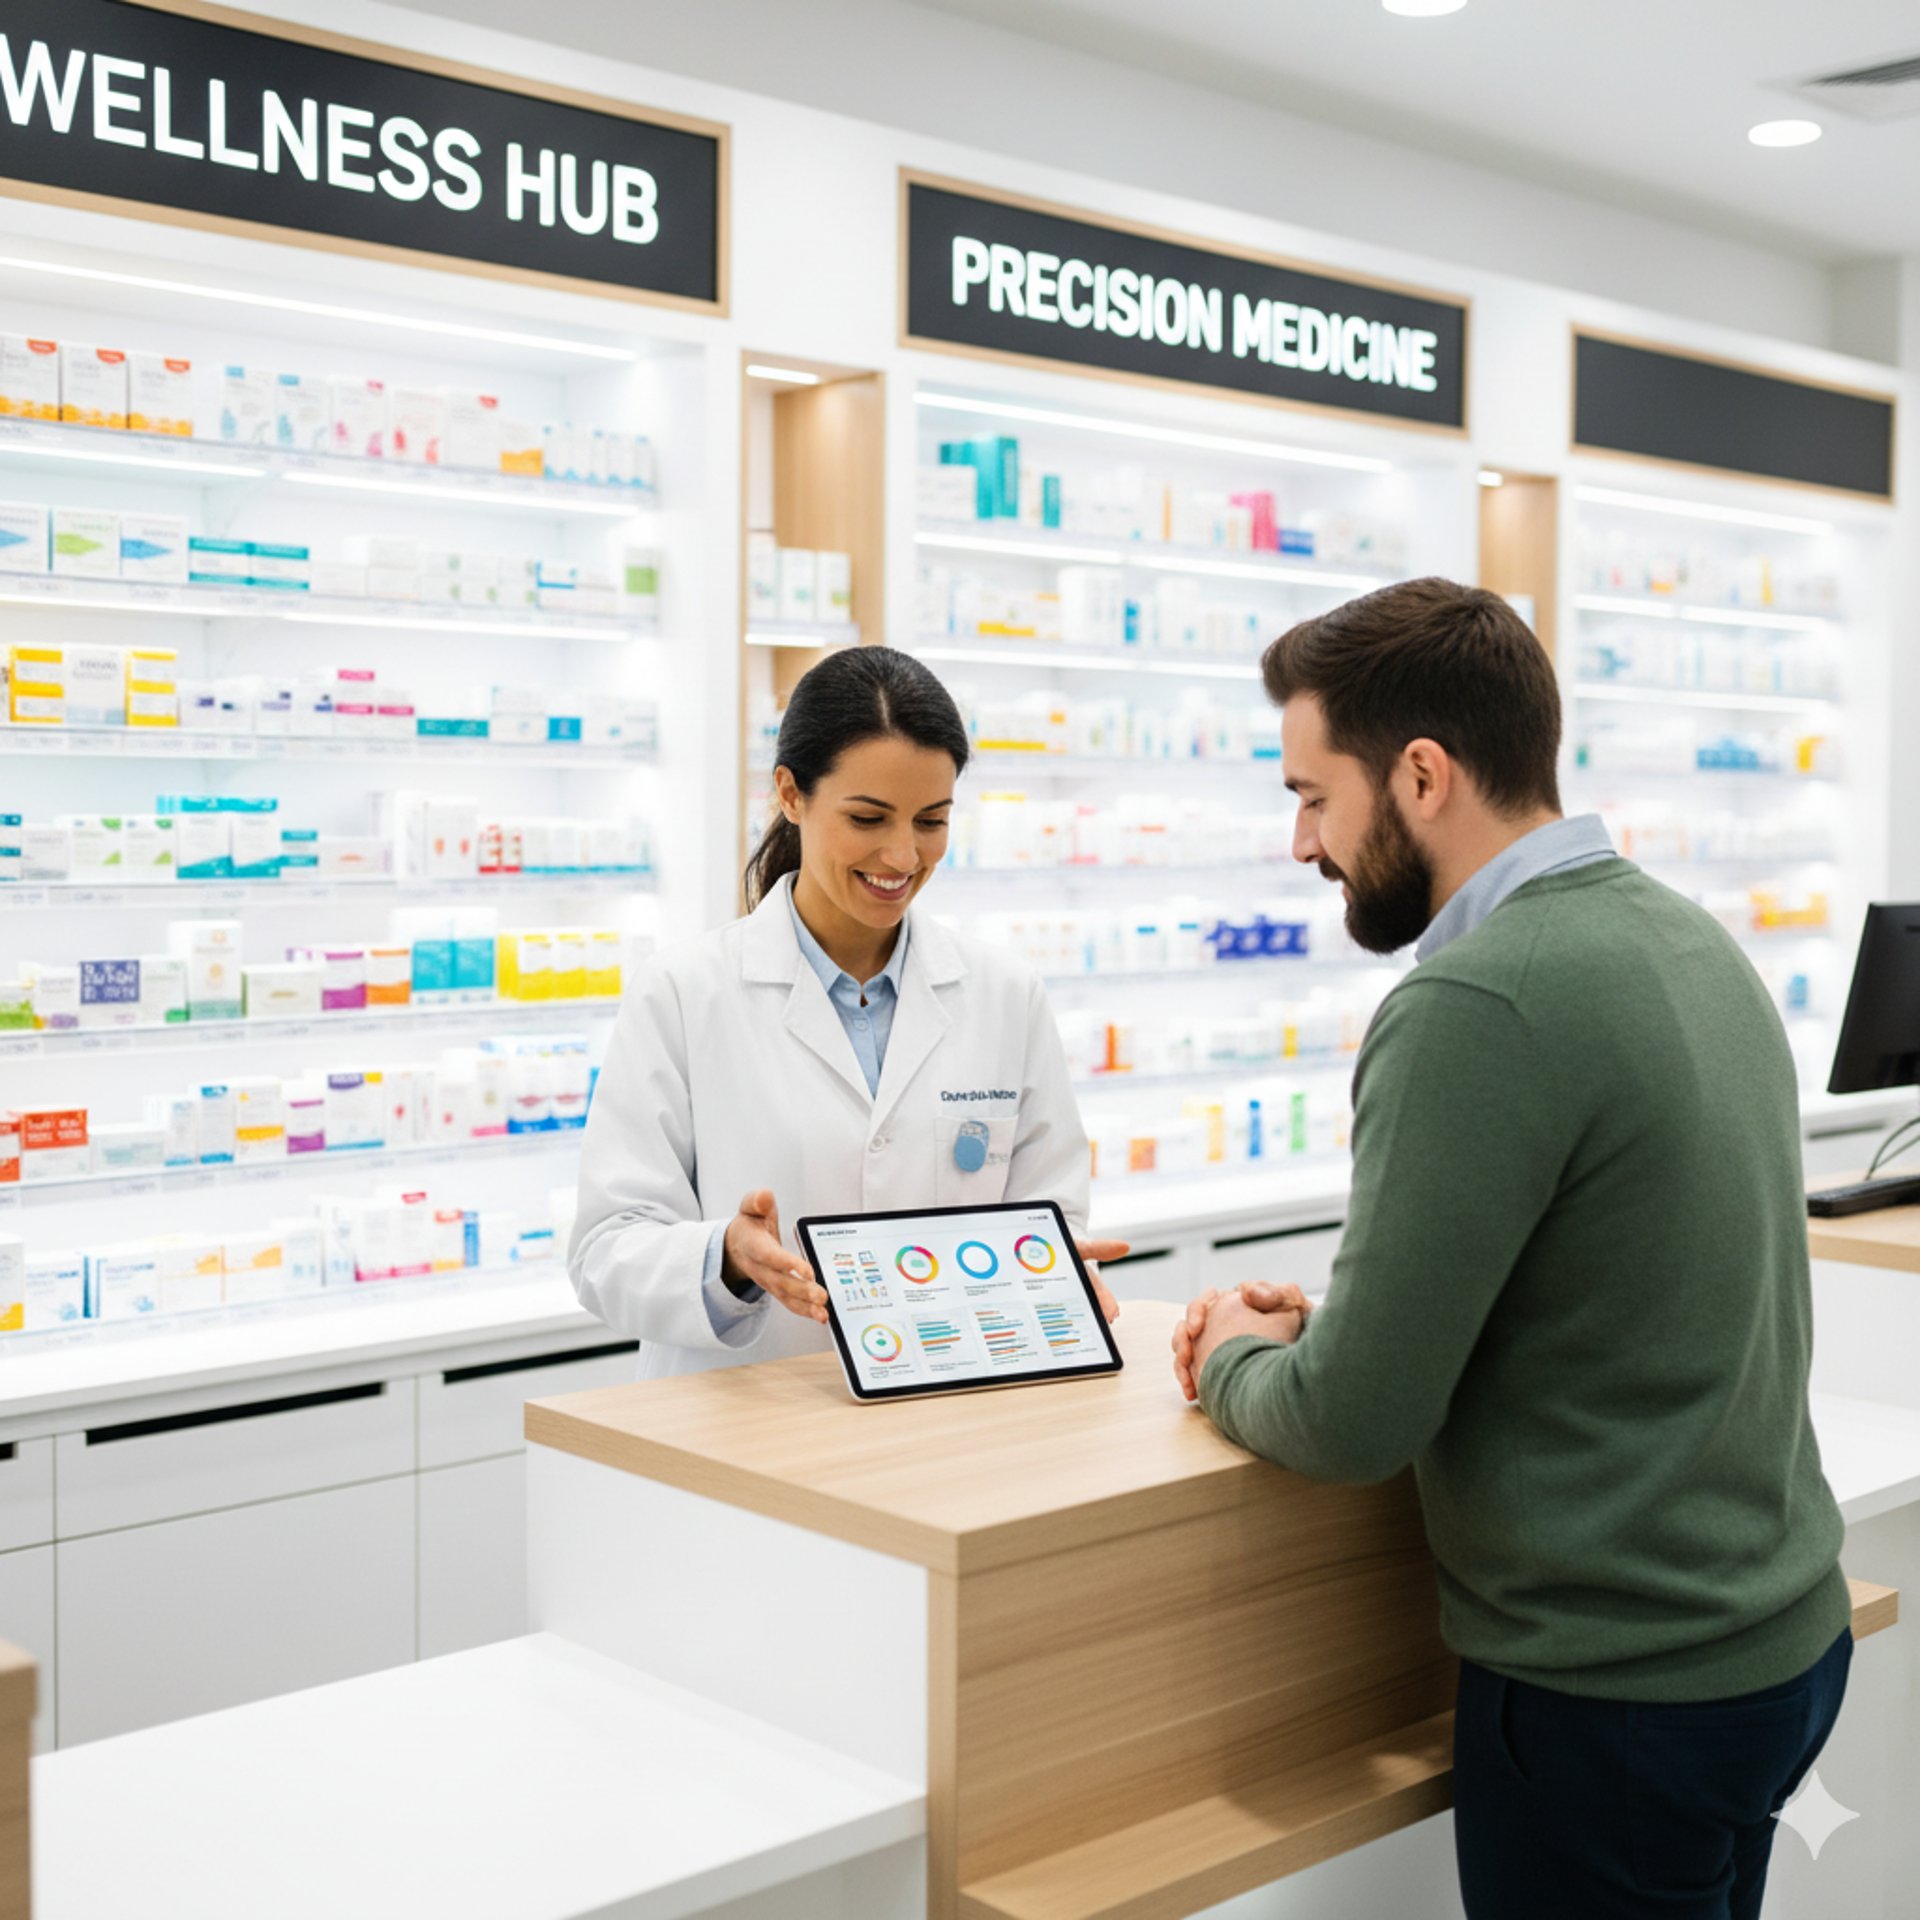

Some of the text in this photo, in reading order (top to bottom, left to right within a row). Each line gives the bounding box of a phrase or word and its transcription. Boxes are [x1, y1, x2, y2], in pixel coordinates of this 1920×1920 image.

[0, 33, 658, 244] WELLNESS HUB
[952, 236, 1437, 391] PRECISION MEDICINE
